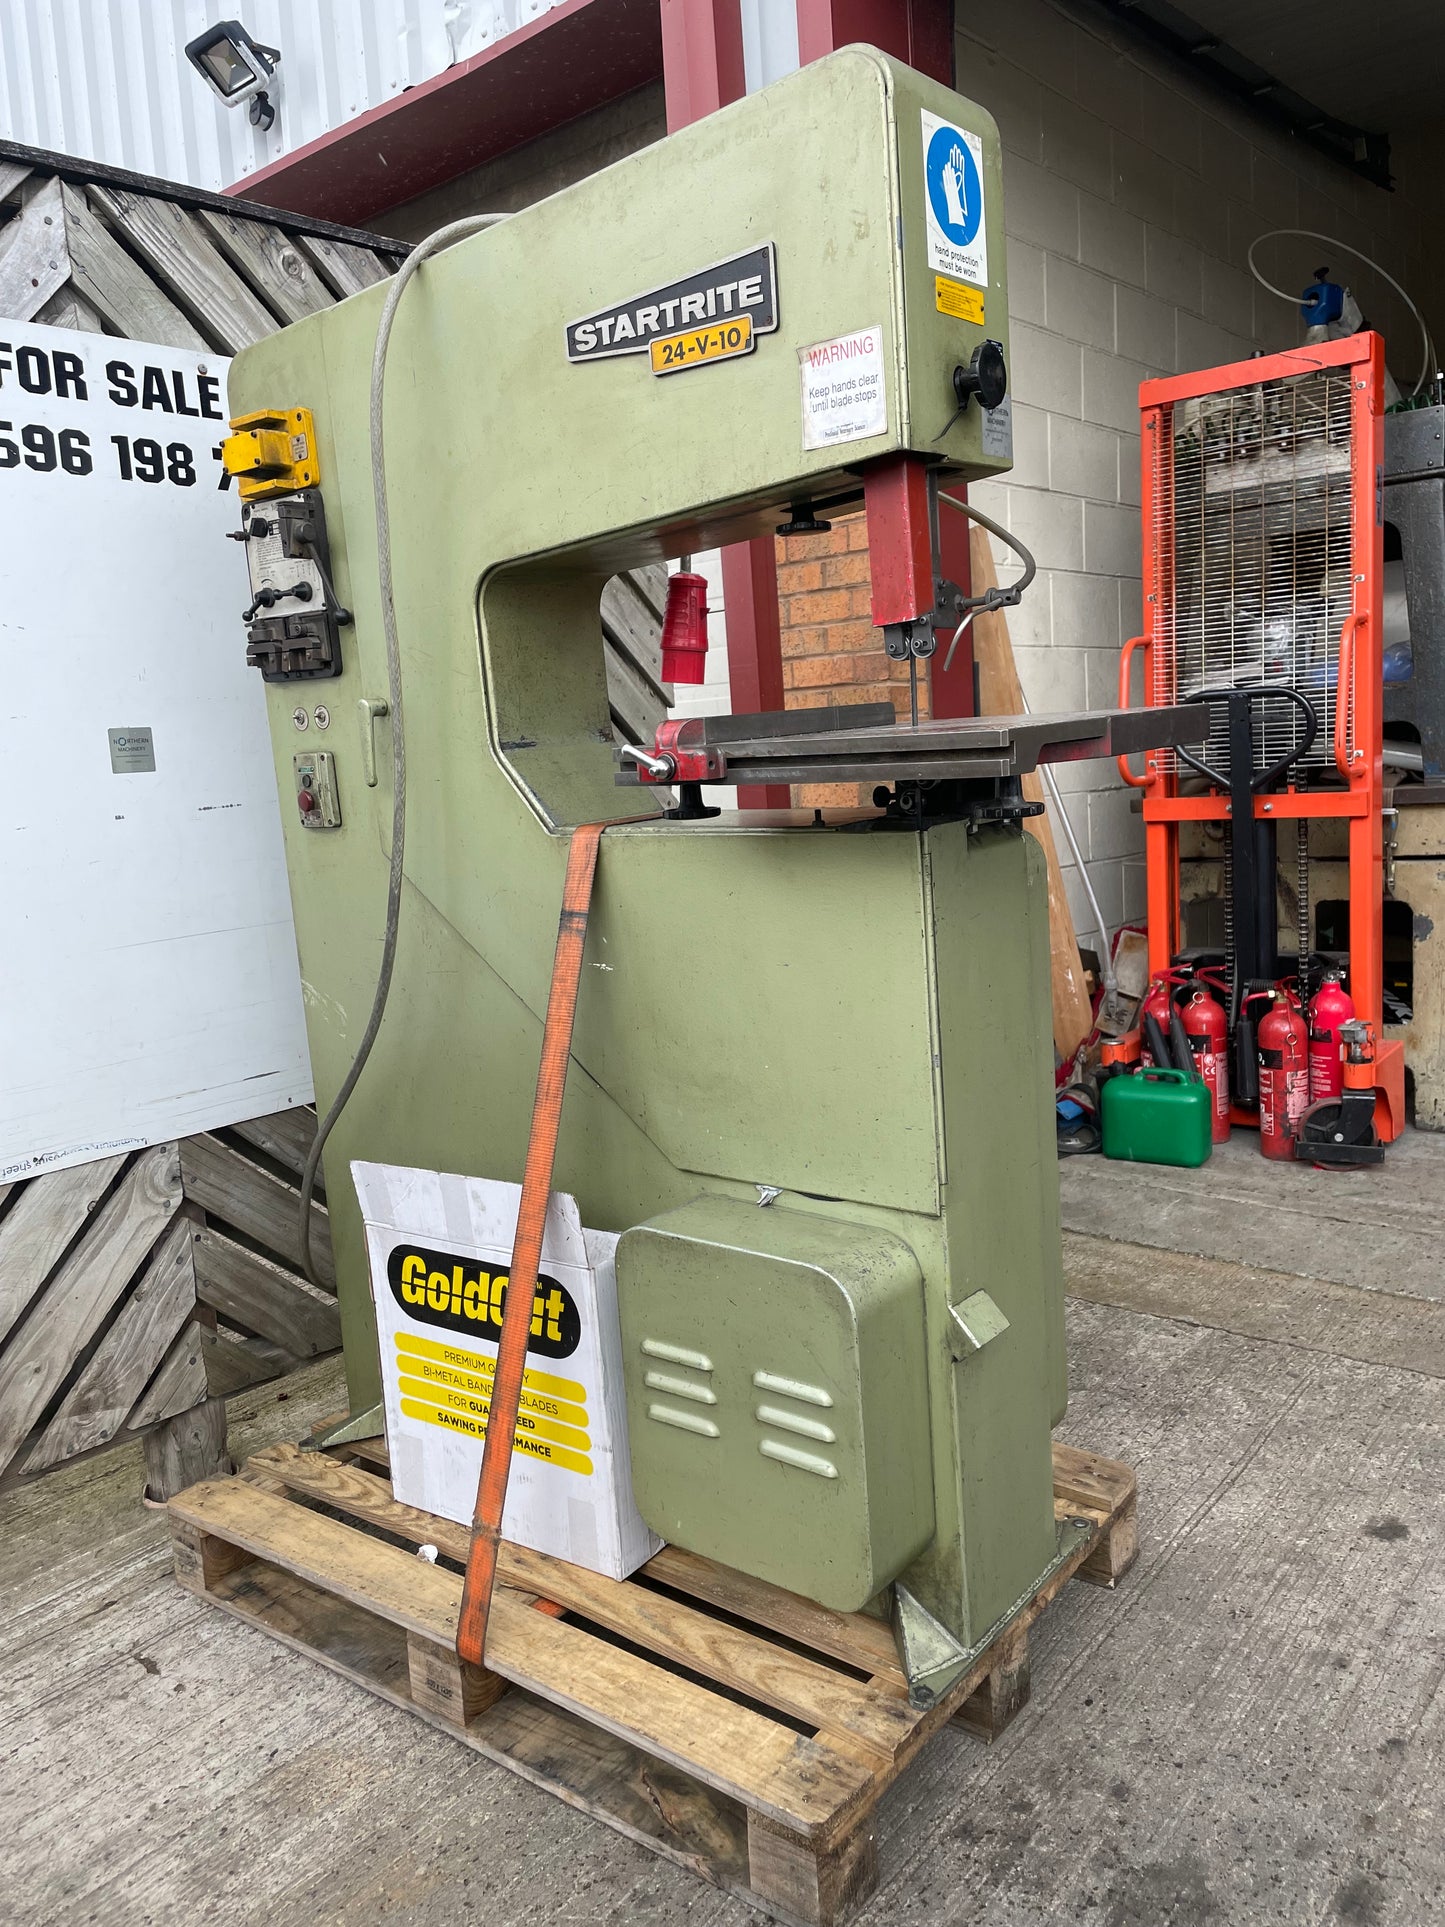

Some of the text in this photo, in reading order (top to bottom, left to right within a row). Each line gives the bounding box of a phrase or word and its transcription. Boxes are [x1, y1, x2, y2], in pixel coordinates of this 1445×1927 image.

[935, 243, 979, 268] hand protection
[939, 259, 977, 279] must be worn
[573, 274, 764, 352] STARTRITE
[661, 327, 742, 365] 24-V-10
[809, 336, 874, 368] WARNING
[105, 360, 223, 420] SALE
[808, 373, 880, 400] Keep hands clear
[812, 388, 878, 413] until blade stops
[0, 421, 93, 476] 596
[110, 434, 197, 487] 198
[444, 1350, 486, 1370] PREMIUM
[423, 1366, 466, 1387] BI-METAL
[519, 1394, 559, 1415] BLADES
[437, 1412, 476, 1433] SAWING
[448, 1394, 536, 1430] FOR GUAEED
